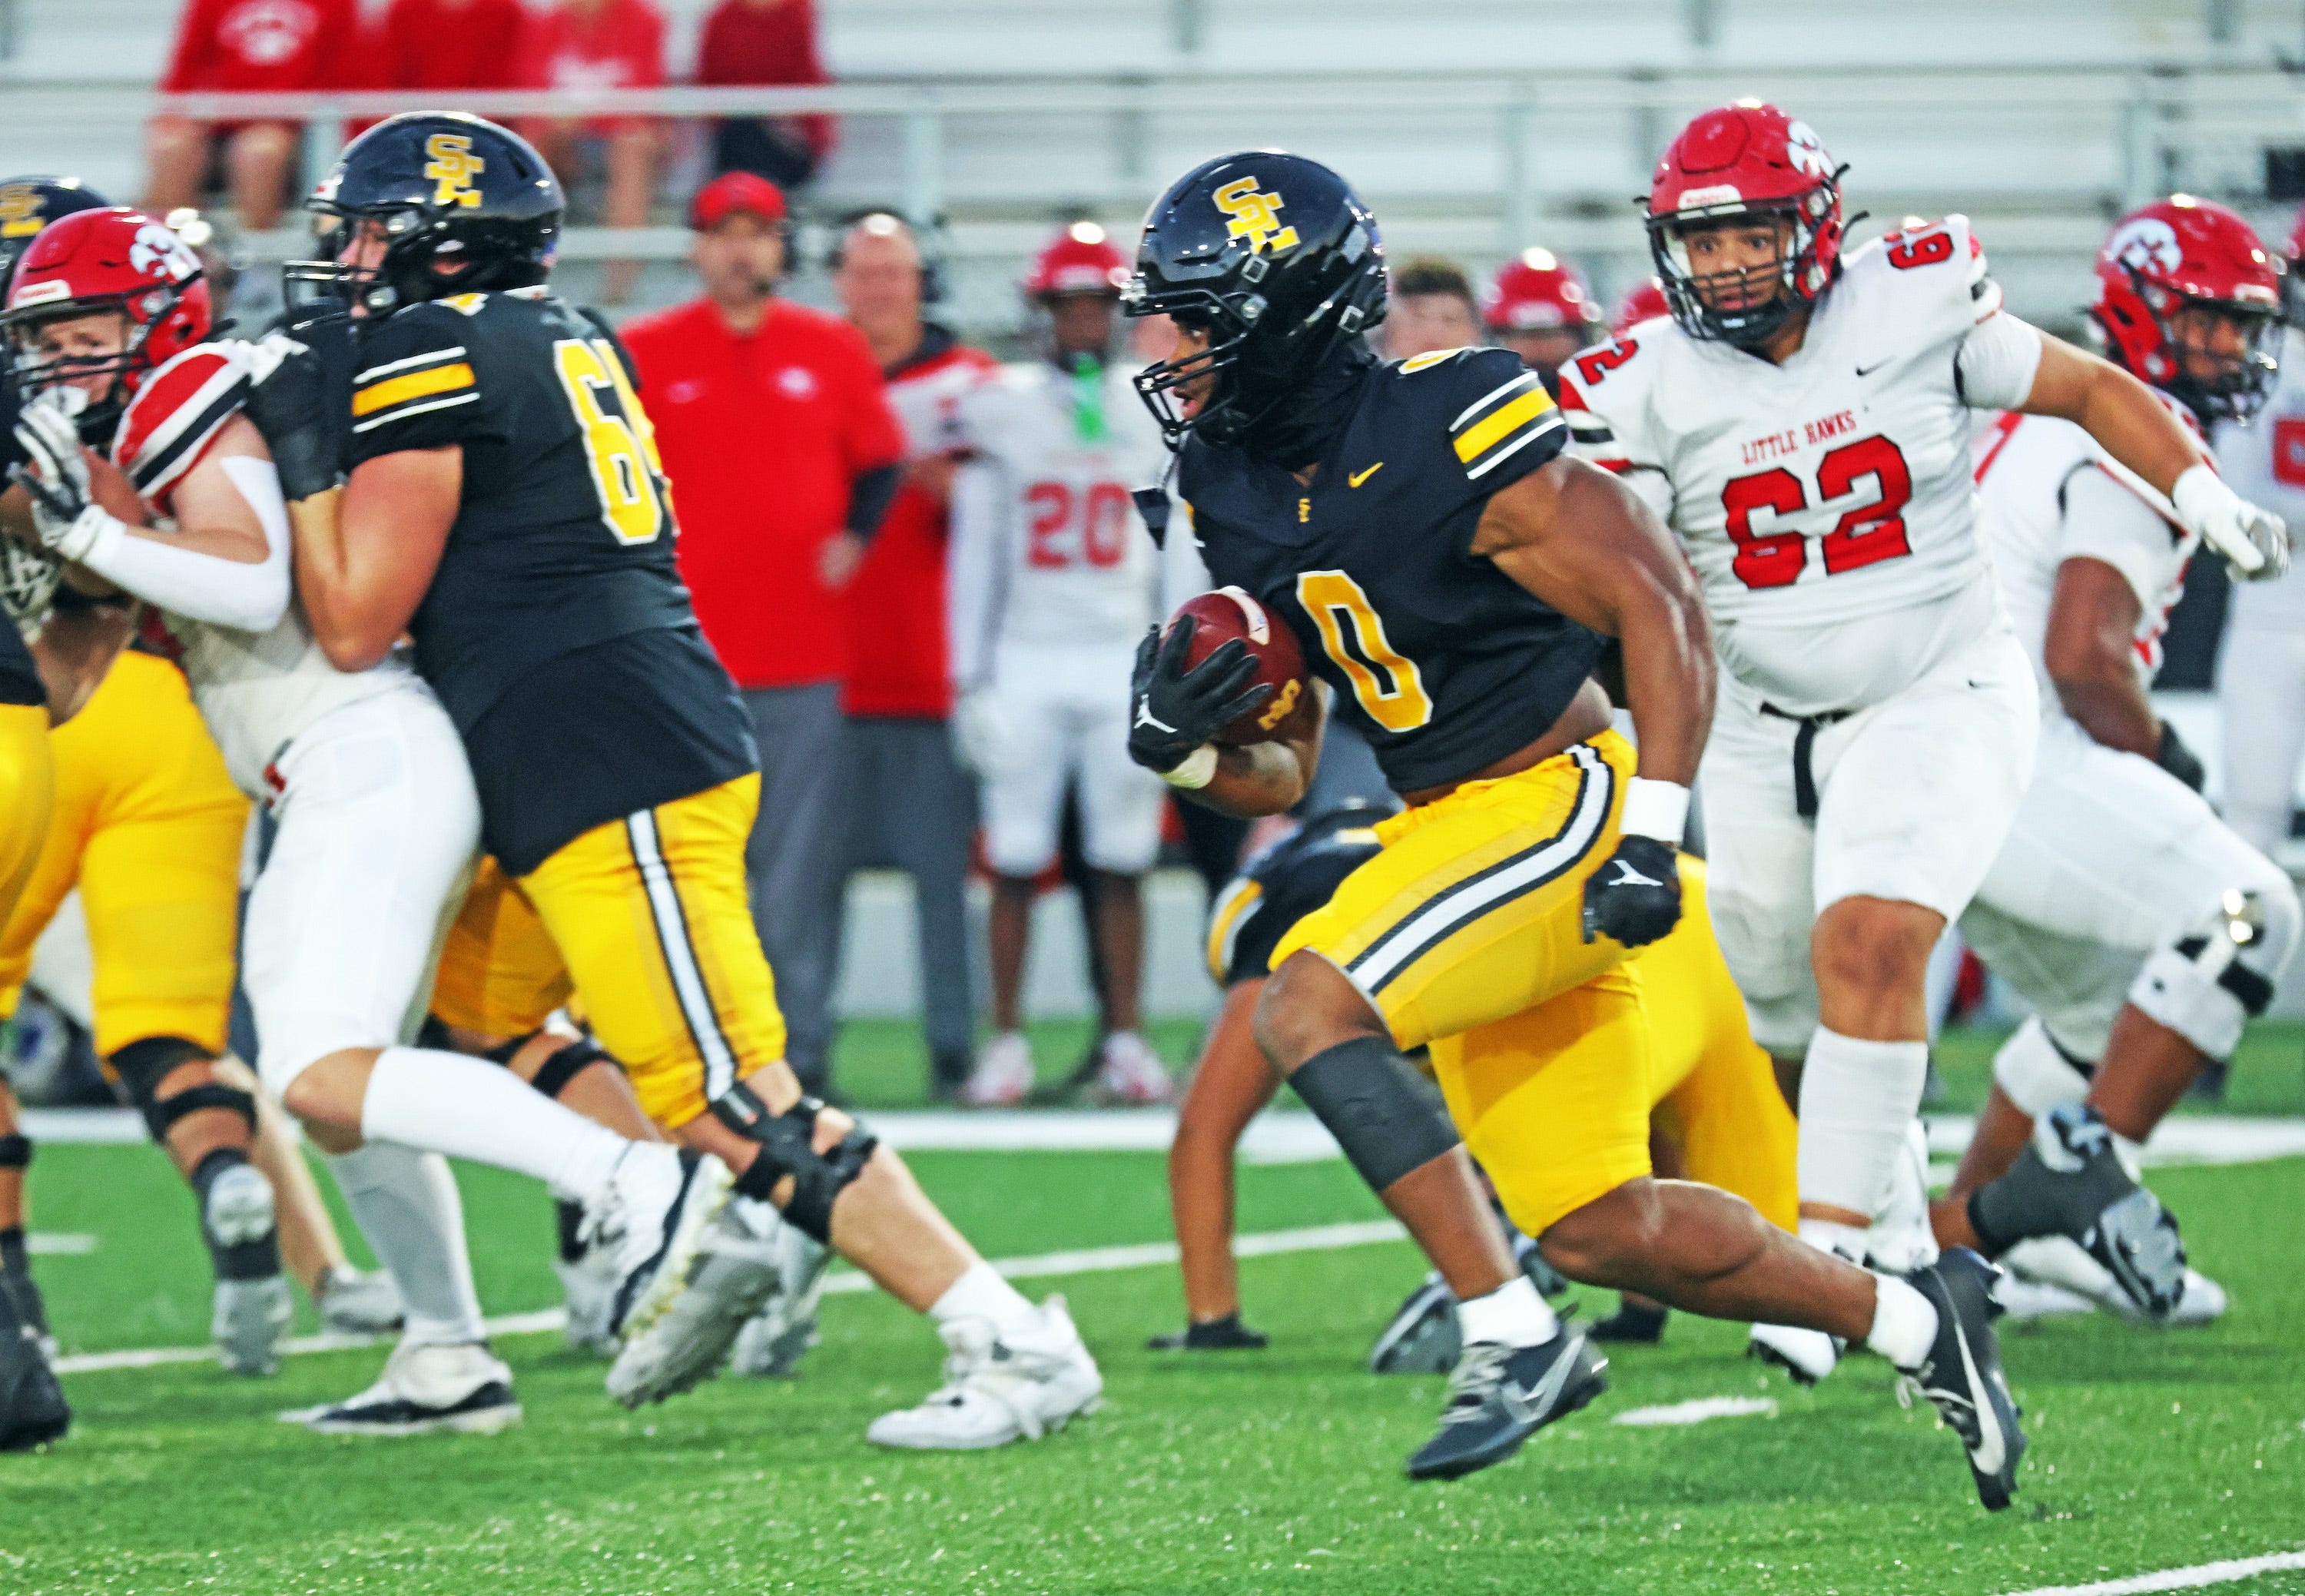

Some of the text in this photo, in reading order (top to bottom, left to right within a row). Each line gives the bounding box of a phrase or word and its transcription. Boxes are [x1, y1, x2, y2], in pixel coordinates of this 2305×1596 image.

[1741, 409, 1857, 466] LITTLE HAWKS
[1023, 479, 1130, 569] 20
[1721, 433, 1913, 590] 62
[1296, 569, 1434, 733] 0
